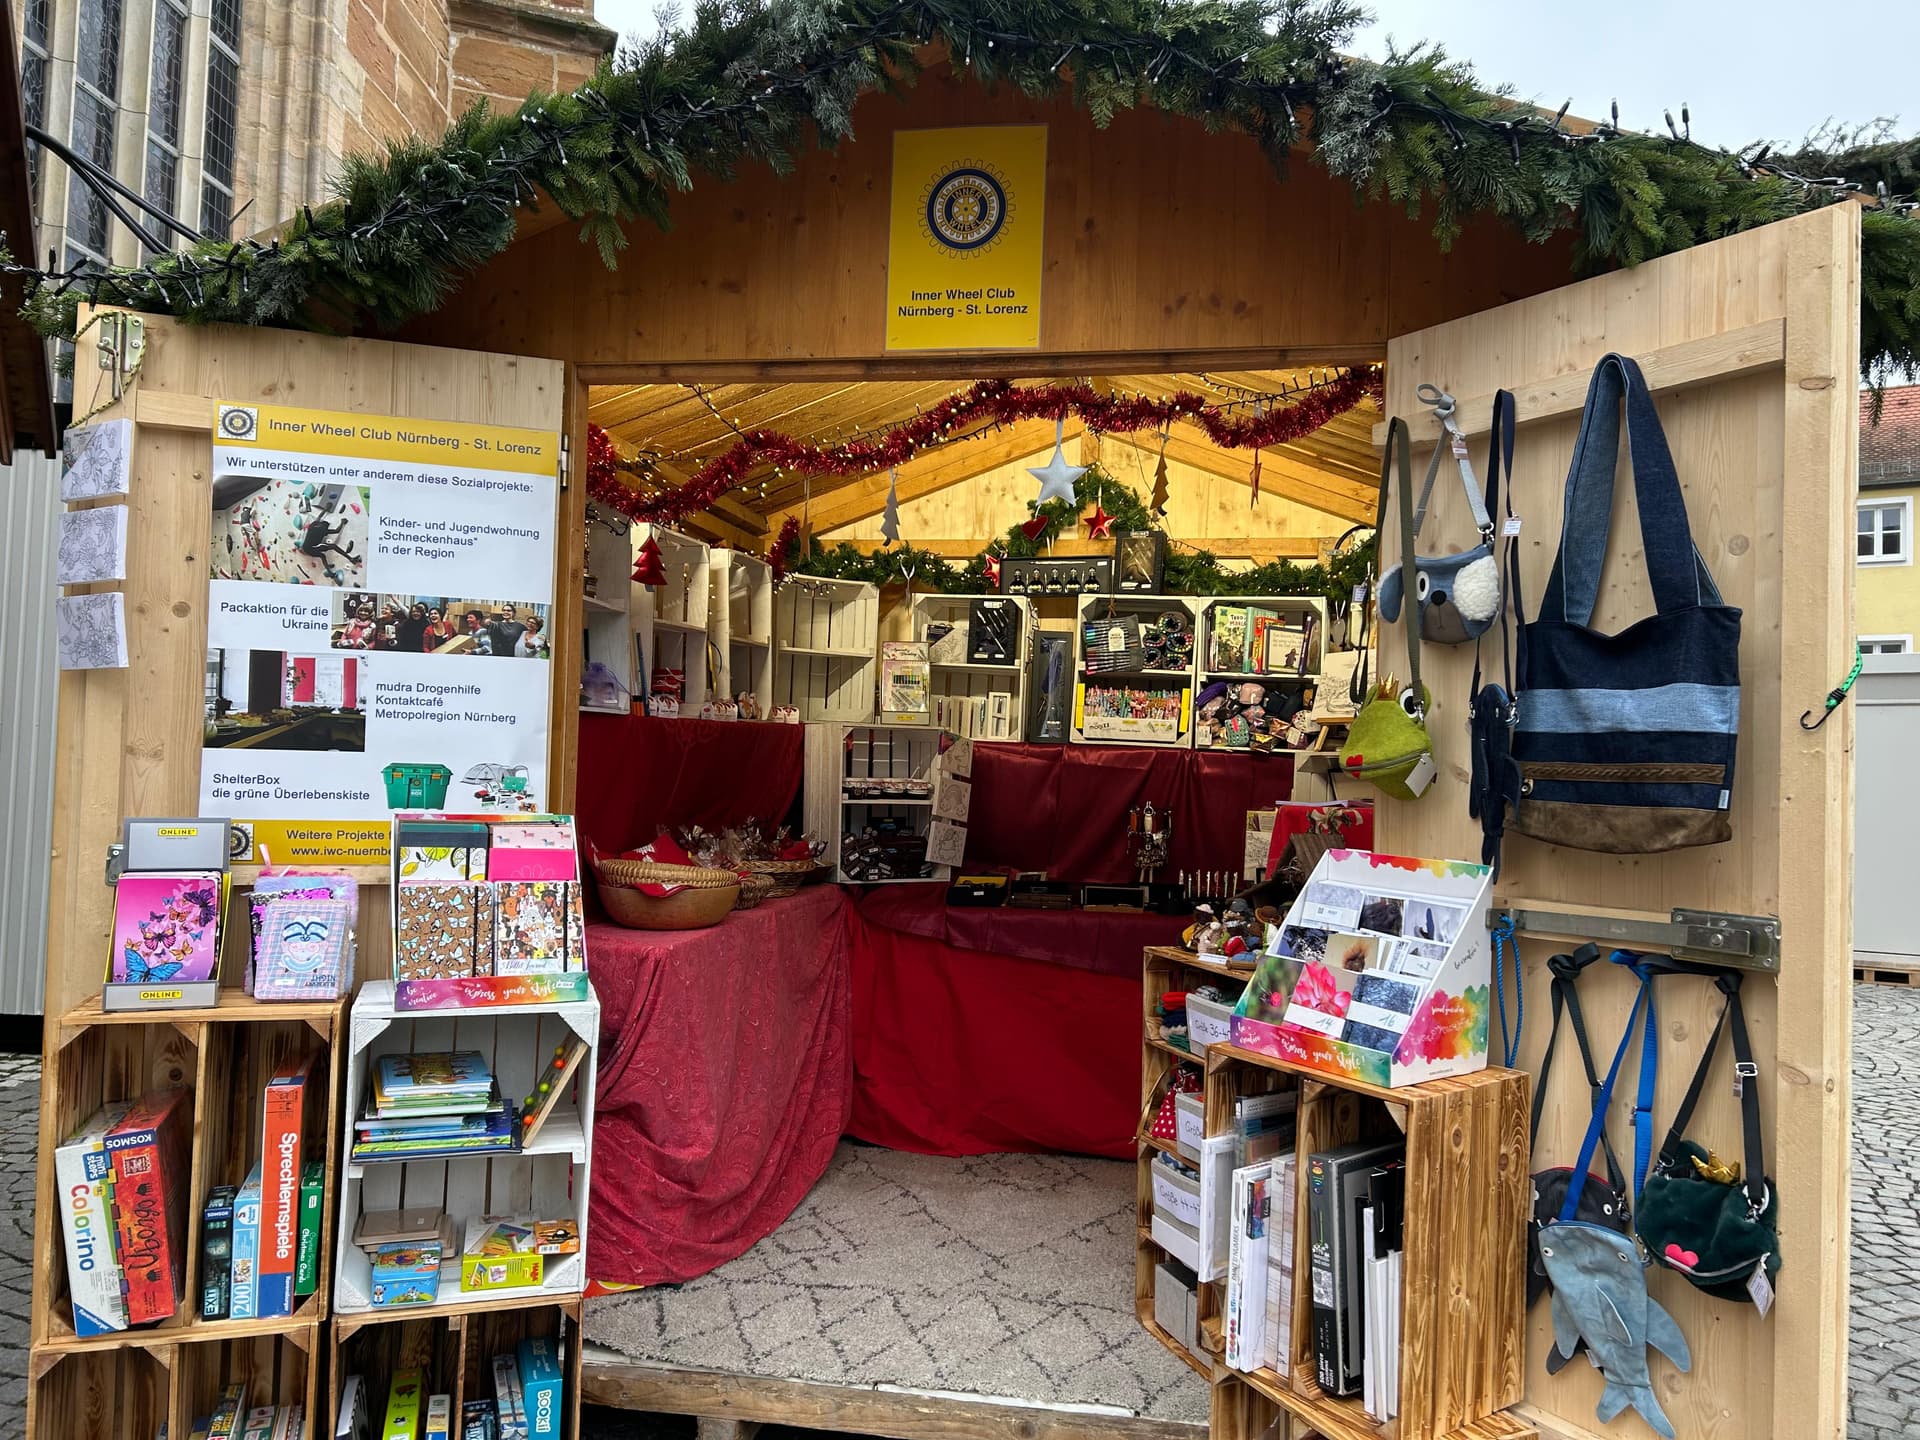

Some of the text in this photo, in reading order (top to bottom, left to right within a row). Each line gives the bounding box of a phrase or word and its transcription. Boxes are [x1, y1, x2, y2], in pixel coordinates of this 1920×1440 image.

[952, 187, 982, 200] INNER
[949, 217, 983, 232] WHEEL
[911, 287, 1015, 301] Inner Wheel Club
[898, 305, 954, 318] Nürnberg
[966, 304, 982, 315] St.
[986, 303, 1028, 315] Lorenz
[269, 419, 307, 433] Inner
[311, 423, 356, 438] Wheel
[360, 427, 392, 442] Club
[397, 431, 460, 450] Nürnberg
[473, 438, 493, 451] St.
[497, 440, 542, 456] Lorenz
[226, 456, 534, 494] Wir unterstützen unter anderem diese Sozialprojekte:
[379, 517, 540, 540] Kinder- und Jugendwohnung
[378, 544, 455, 559] in der Region
[220, 601, 329, 617] Packaktion für die
[282, 619, 329, 631] Ukraine
[376, 682, 481, 696] mudra Drogenhilfe
[376, 695, 444, 707] Kontaktcafé
[375, 708, 516, 725] Metropolregion Nürnberg
[213, 774, 281, 786] ShelterBox
[212, 786, 370, 802] die grüne Überlebenskiste
[286, 829, 333, 841] Weitere
[337, 829, 385, 844] Projekte
[105, 1133, 152, 1149] KOSMOS
[86, 1155, 98, 1179] steps
[95, 1155, 107, 1175] mini
[276, 1132, 297, 1259] Sprechlernspiele
[70, 1183, 95, 1272] Colorino
[123, 1199, 161, 1271] Ubongo
[298, 1228, 310, 1283] Christmas Cards
[205, 1291, 217, 1314] EXIT
[233, 1285, 250, 1315] 200
